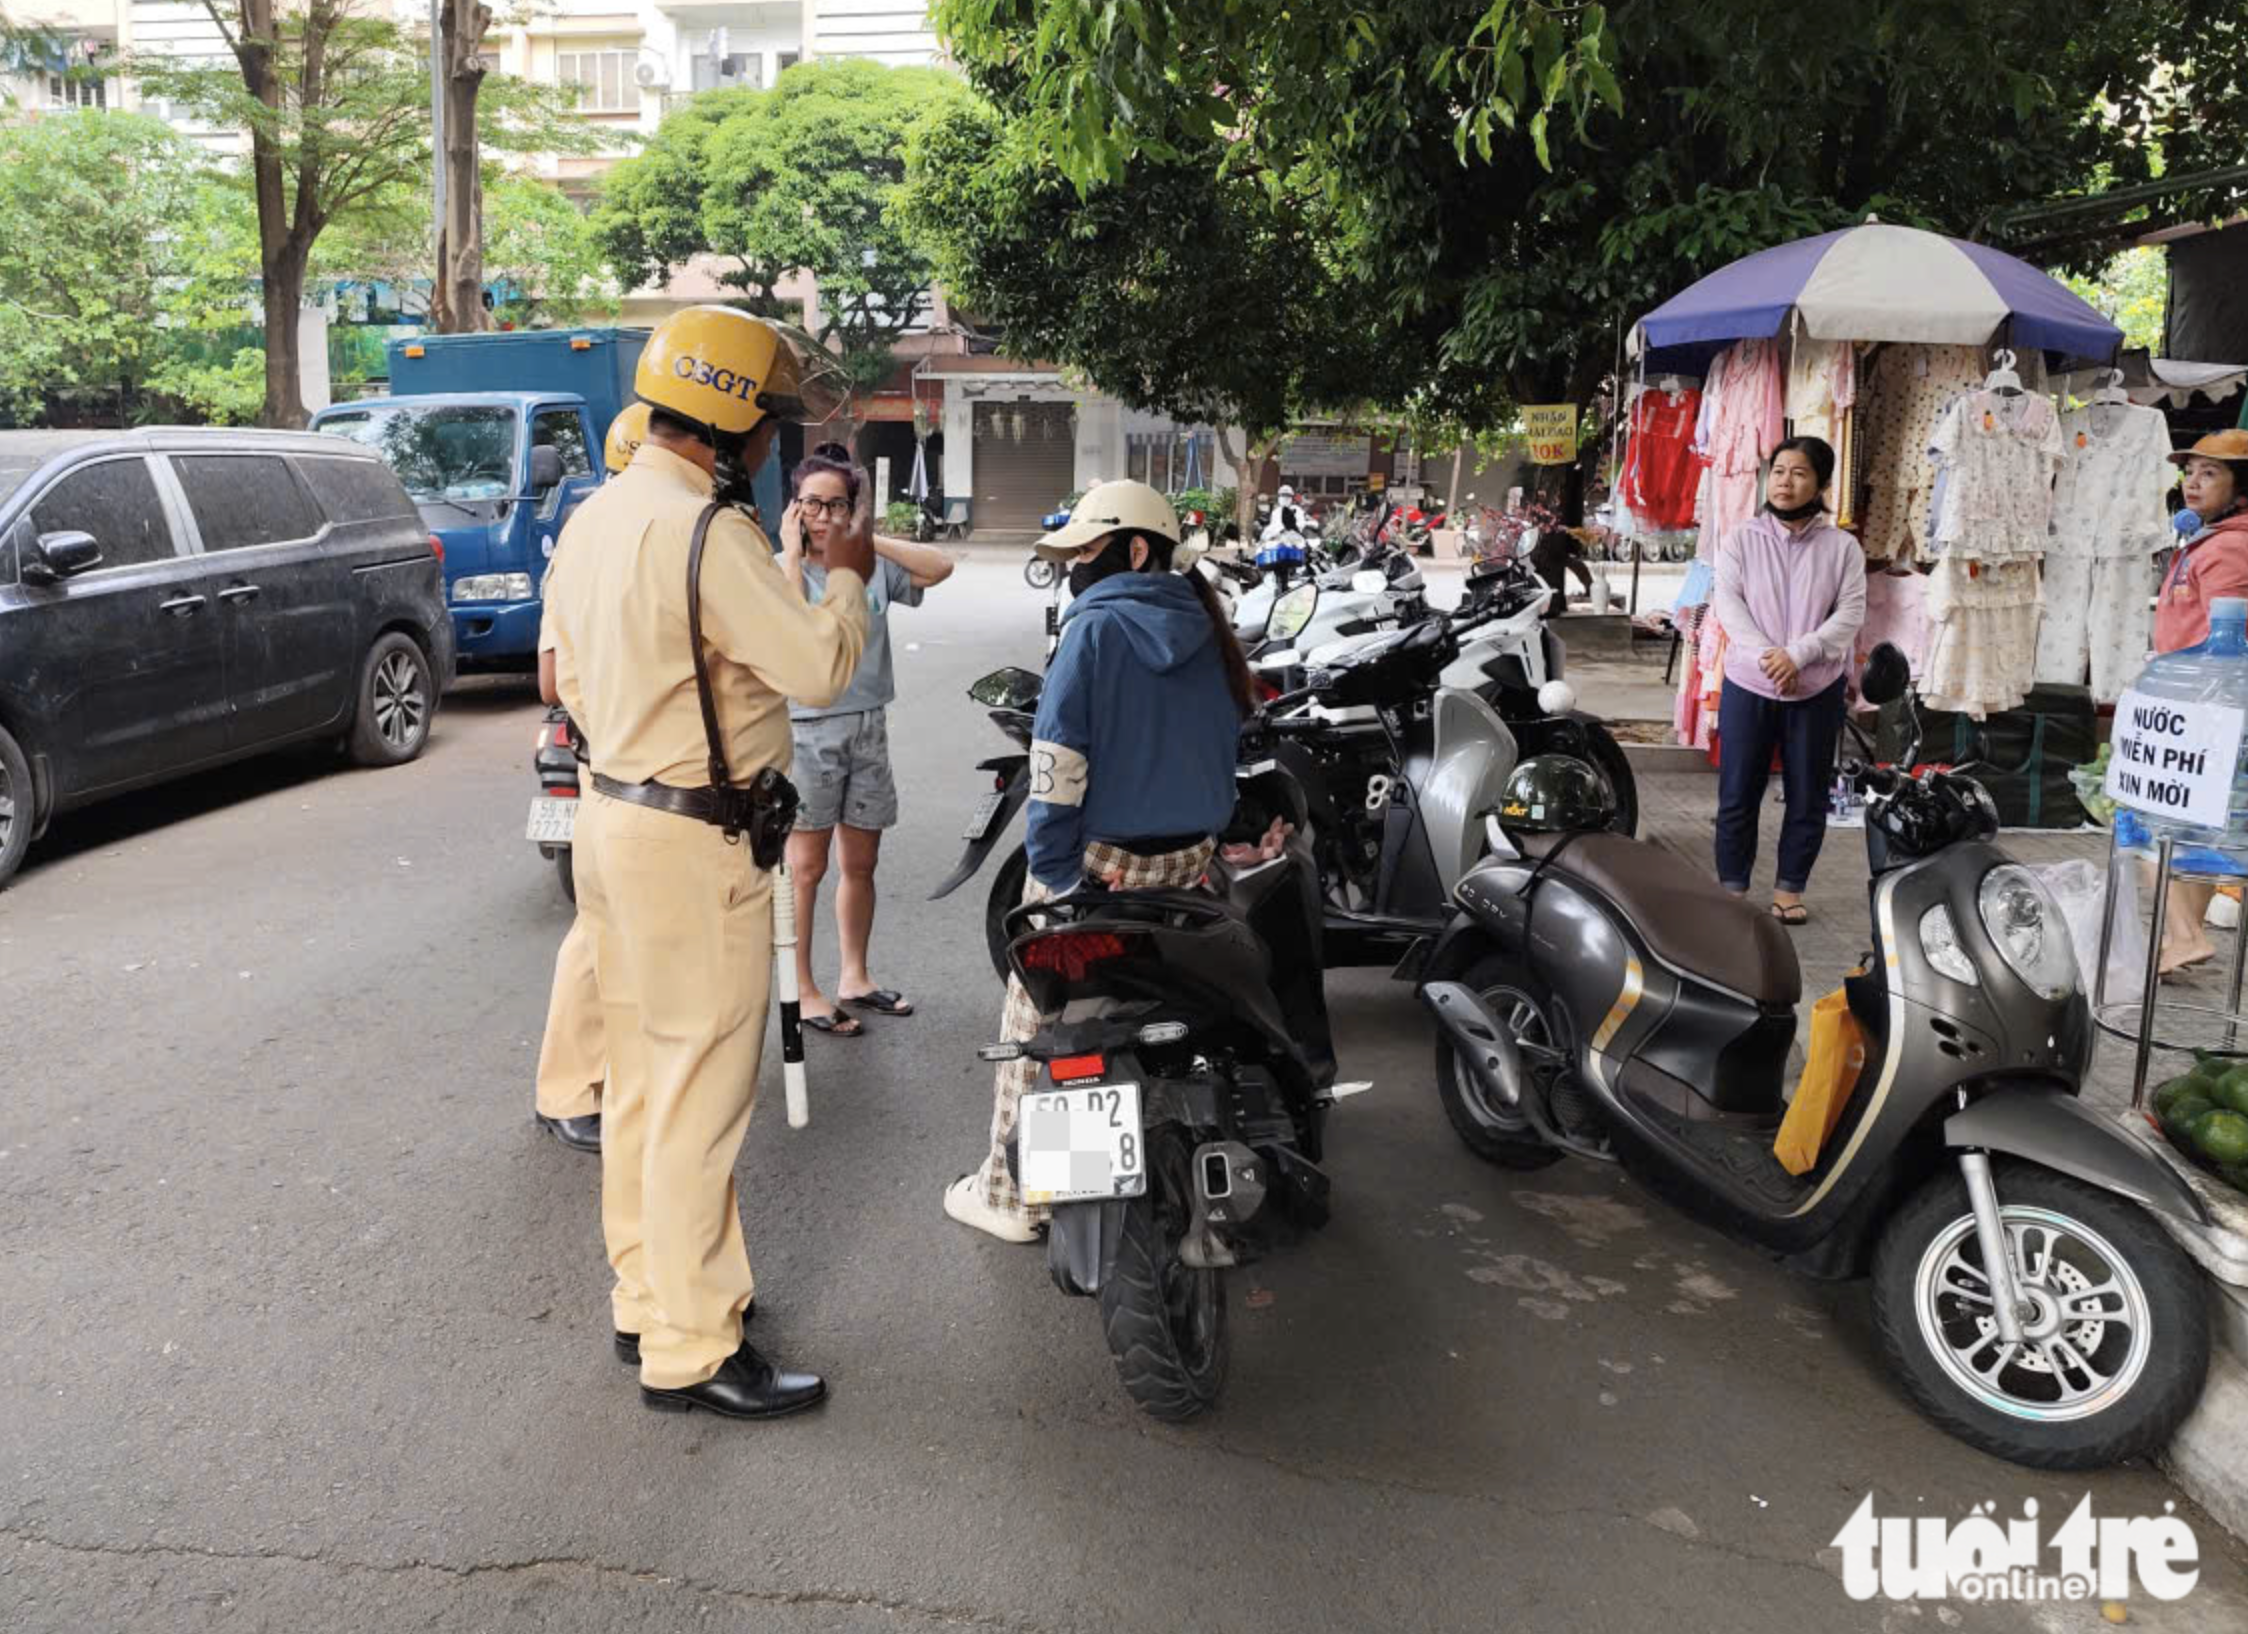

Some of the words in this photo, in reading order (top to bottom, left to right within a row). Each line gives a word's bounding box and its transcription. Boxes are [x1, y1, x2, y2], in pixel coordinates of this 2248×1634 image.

[675, 356, 757, 402] CSGT
[616, 440, 641, 456] CS
[1532, 443, 1566, 460] 10K
[2133, 705, 2186, 736] NƯỚC
[2163, 748, 2208, 775] PHÍ
[2118, 769, 2141, 797] XIN
[2147, 778, 2190, 808] MỜI
